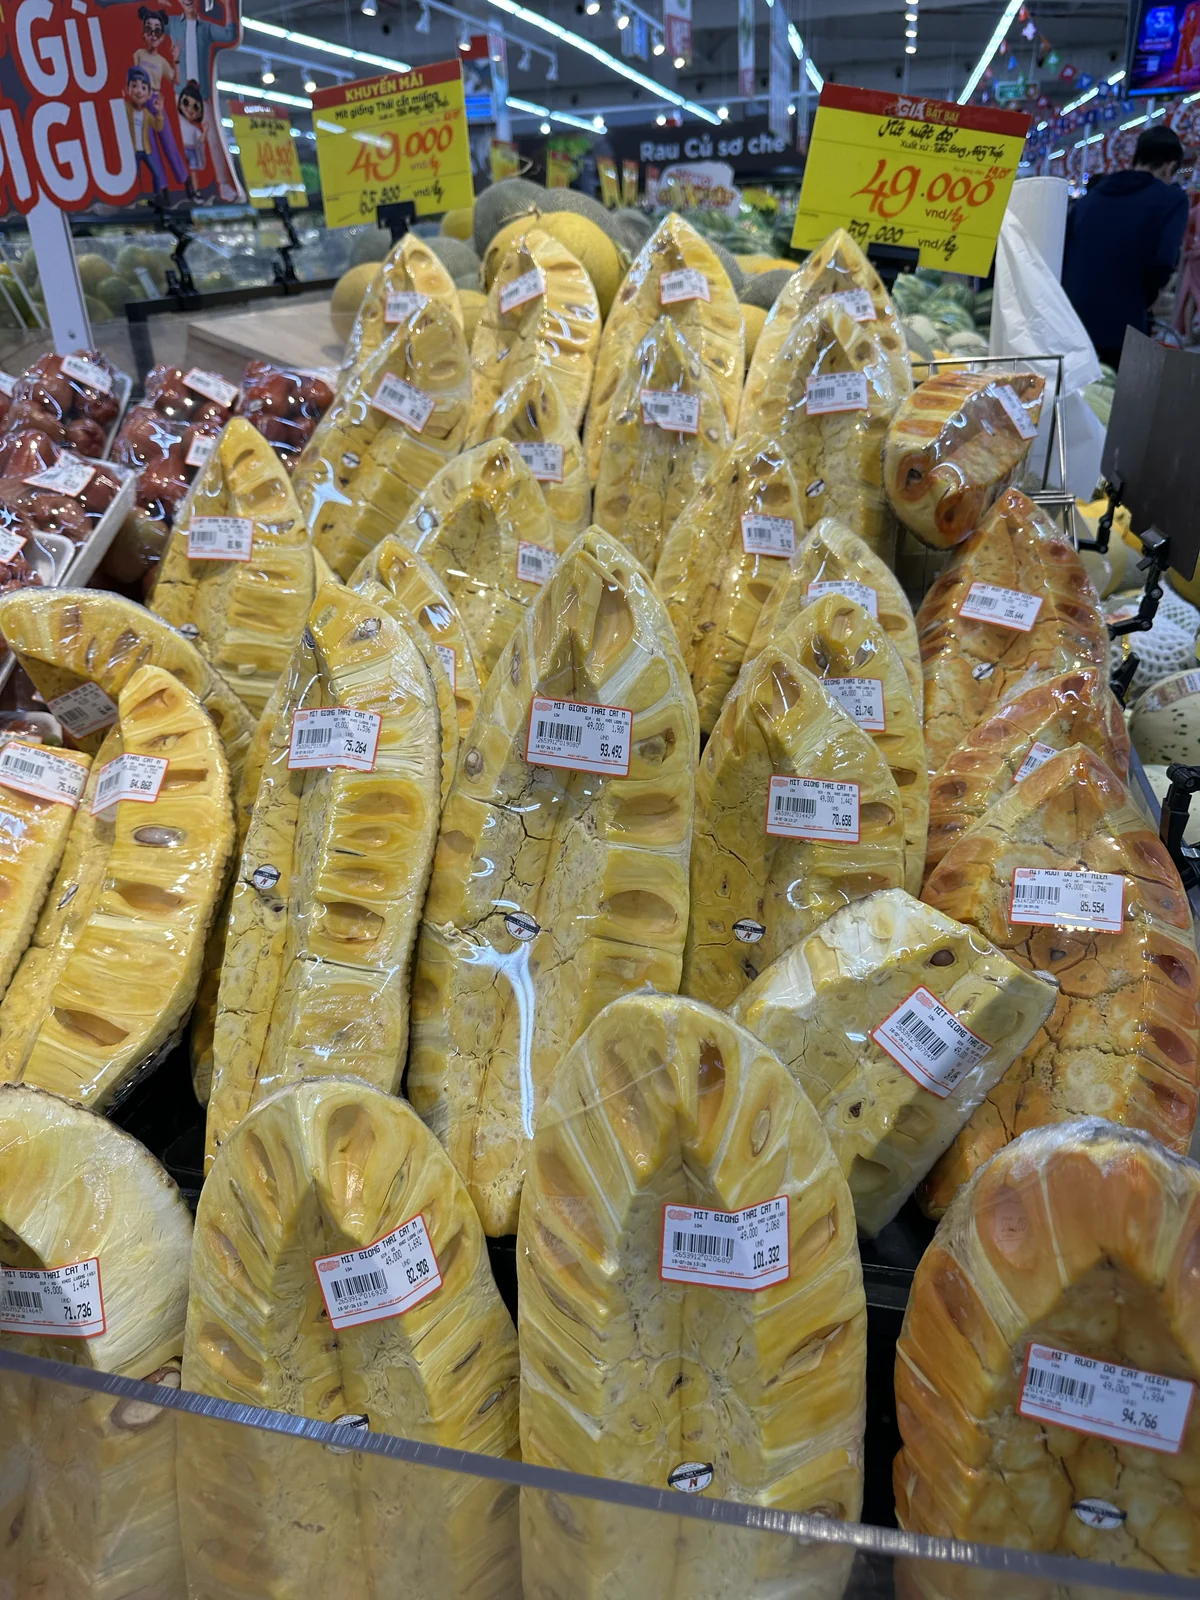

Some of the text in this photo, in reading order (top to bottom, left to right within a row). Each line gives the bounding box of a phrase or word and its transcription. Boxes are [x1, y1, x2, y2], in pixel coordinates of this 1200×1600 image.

[16, 0, 107, 97] GÙ
[345, 74, 424, 102] KHUYẾN MÃI
[351, 103, 374, 117] giống
[376, 99, 395, 112] Thái
[397, 95, 409, 108] cắt
[32, 98, 137, 202] GU
[347, 125, 453, 182] 49.000
[640, 141, 680, 162] Rau
[684, 134, 713, 158] Củ
[718, 136, 743, 158] sơ
[851, 159, 996, 218] 49.000
[338, 709, 351, 717] THAI
[354, 712, 366, 720] CAT
[568, 704, 588, 714] GIONG
[591, 708, 606, 716] THAI
[855, 706, 874, 717] 61.740
[587, 722, 625, 735] 49.000 1.908
[344, 740, 368, 755] 75.264
[600, 743, 623, 759] 93.492
[130, 779, 153, 791] 84.868
[803, 780, 820, 788] GIONG
[822, 782, 834, 790] THAI
[832, 814, 852, 827] 70.658
[1065, 883, 1107, 893] 49.000 1.746
[1080, 900, 1105, 914] 85.554
[934, 1005, 948, 1019] MIT
[947, 1018, 968, 1038] GIONG
[694, 1202, 780, 1224] MIT GIONG THAI CAT M
[740, 1219, 780, 1241] 49.000 2.068
[341, 1221, 418, 1265] MIT GIONG THAI CAT M
[386, 1250, 403, 1267] 49.000
[674, 1250, 731, 1264] 2653912 020680
[753, 1245, 780, 1270] 101.332
[20, 1271, 40, 1279] GIONG
[43, 1270, 61, 1280] THAI
[65, 1265, 79, 1276] CAT
[84, 1263, 89, 1271] M
[406, 1259, 430, 1285] 82.908
[44, 1280, 90, 1295] 49.000 1.464
[337, 1288, 387, 1305] 2653912 016928
[64, 1302, 92, 1320] 71.736
[1052, 1351, 1069, 1362] MIT
[1074, 1356, 1098, 1369] RUOT
[1103, 1364, 1116, 1375] DO
[1121, 1369, 1139, 1380] CAT
[1144, 1374, 1171, 1387] MIEN
[1103, 1381, 1130, 1395] 49.000
[1122, 1408, 1158, 1429] 94.766
